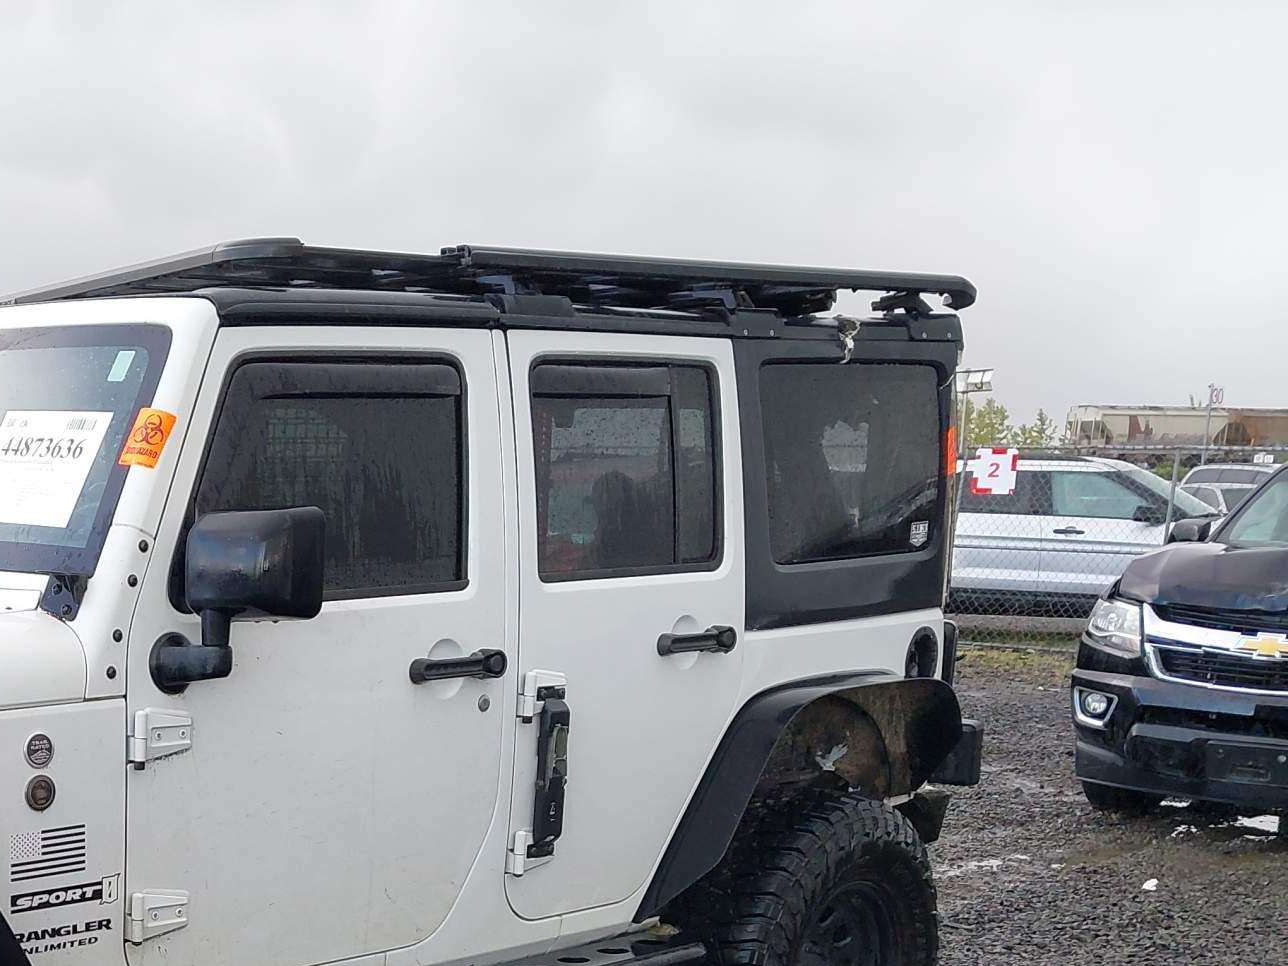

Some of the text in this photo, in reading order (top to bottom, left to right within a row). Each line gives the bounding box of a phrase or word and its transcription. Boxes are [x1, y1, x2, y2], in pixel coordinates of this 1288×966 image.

[2, 436, 88, 459] 44873636
[987, 462, 1000, 478] 2
[15, 884, 102, 909] SPORT
[14, 918, 112, 943] RANGLER
[23, 936, 98, 955] NLIMITED
